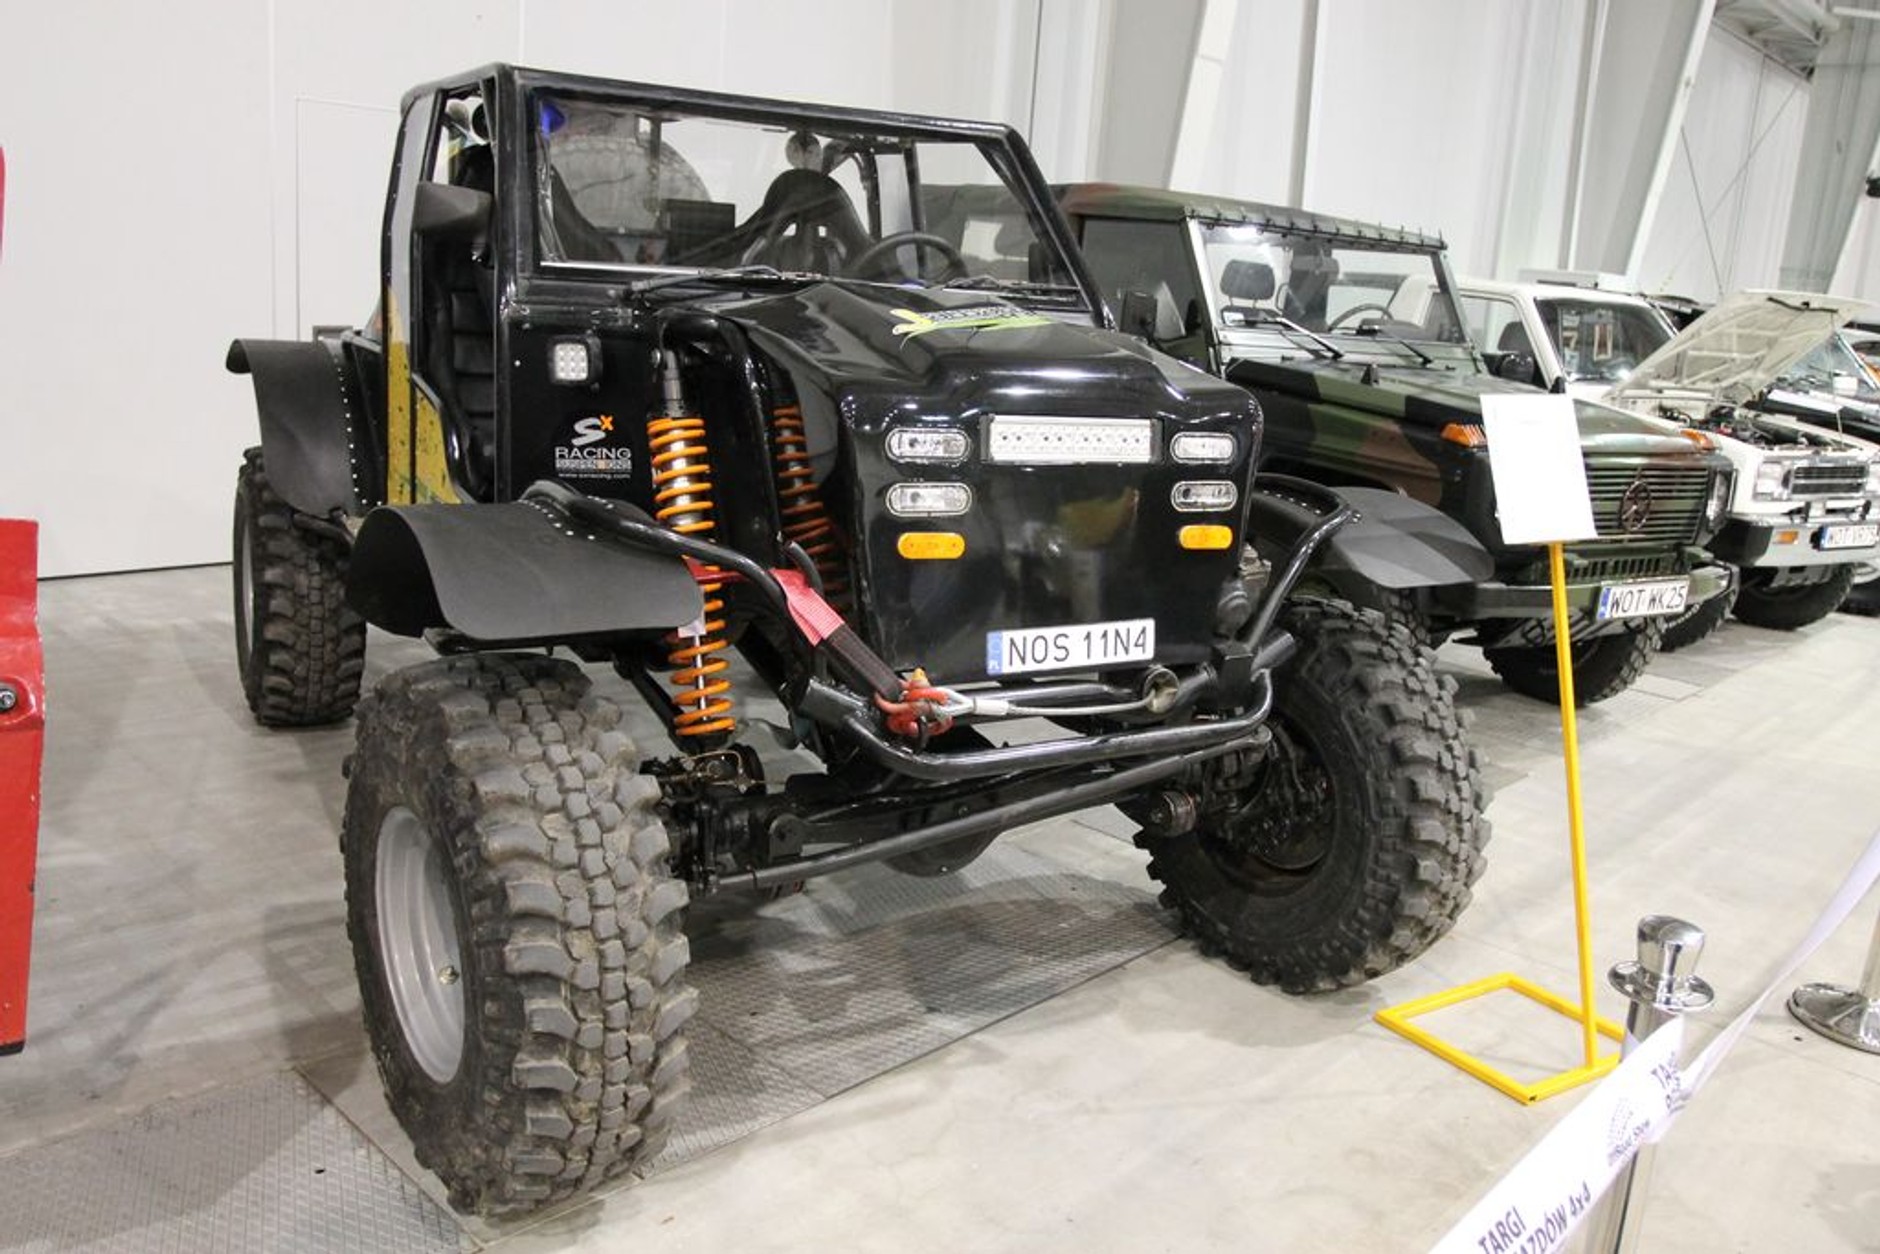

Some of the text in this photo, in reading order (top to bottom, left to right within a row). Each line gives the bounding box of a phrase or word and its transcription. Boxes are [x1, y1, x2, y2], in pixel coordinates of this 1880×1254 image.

[555, 446, 632, 459] RACING
[1610, 585, 1686, 613] WOT WK25
[1009, 625, 1147, 667] NOS 11N4
[1568, 1179, 1592, 1215] 4x4
[1477, 1204, 1527, 1254] TARGI
